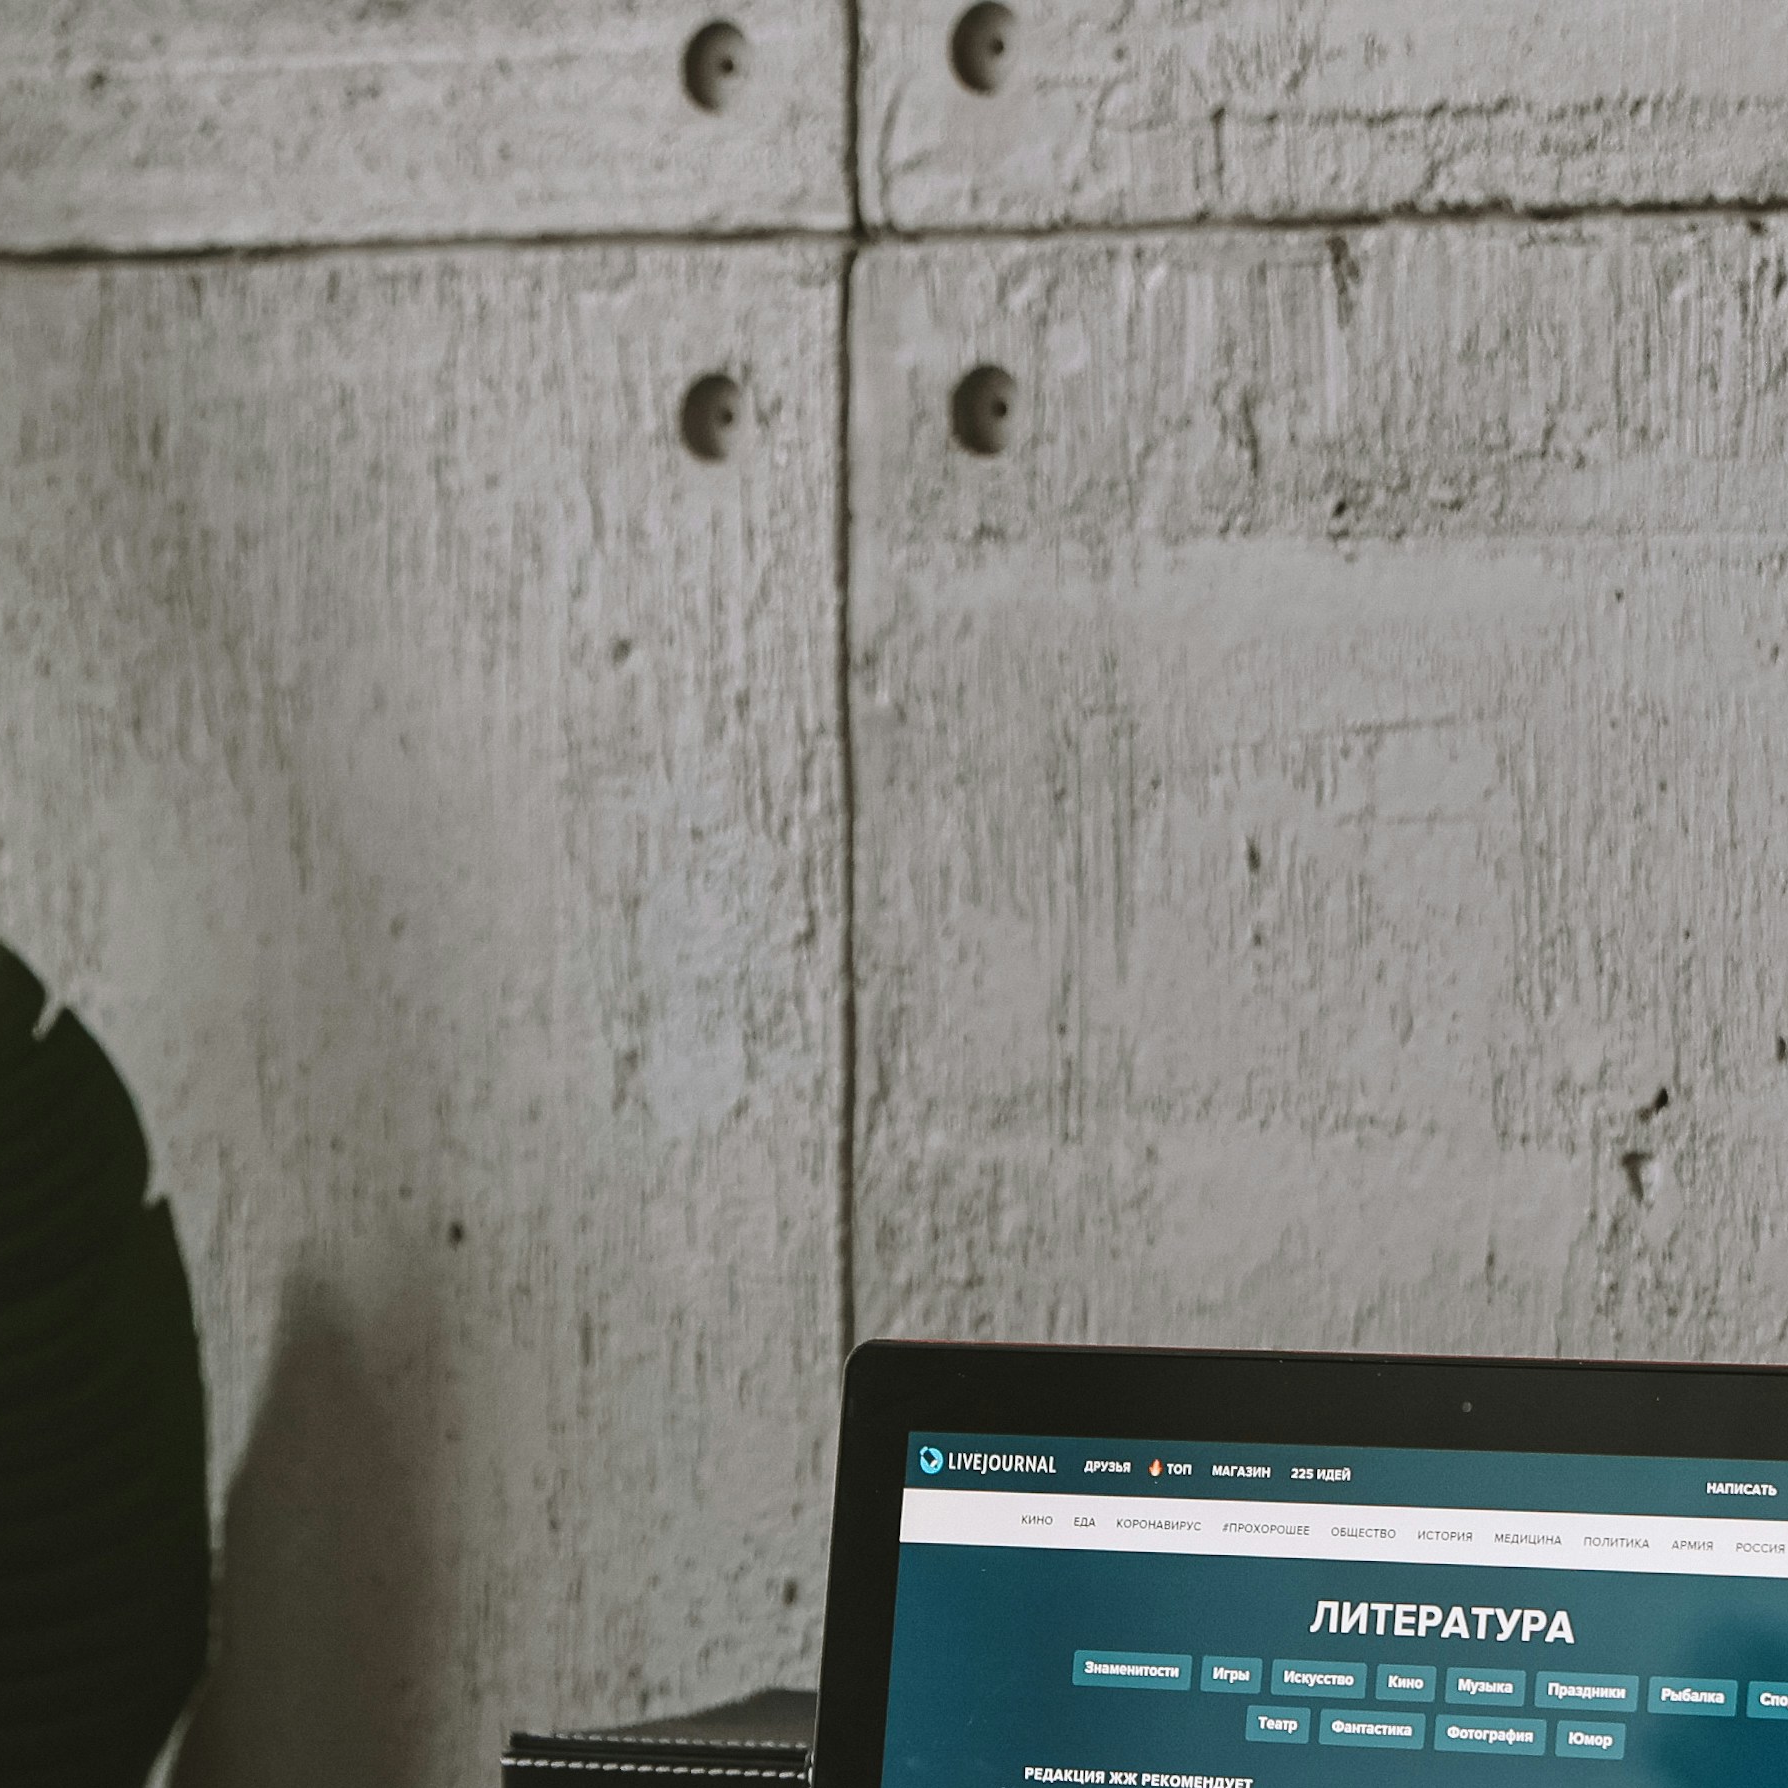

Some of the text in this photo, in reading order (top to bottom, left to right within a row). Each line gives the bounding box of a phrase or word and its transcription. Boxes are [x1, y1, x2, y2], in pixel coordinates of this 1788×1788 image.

[947, 1452, 1057, 1475] LIVEJOURNAL
[1083, 1459, 1131, 1474] ДРУЗЬЯ
[1167, 1462, 1192, 1476] ТОП
[1212, 1464, 1271, 1479] МАГАЗИН
[1290, 1466, 1352, 1482] 225 ИДЕЙ
[1706, 1481, 1778, 1498] НАПИСАТЬ
[1021, 1515, 1053, 1526] КИНО
[1073, 1516, 1096, 1529] ЕДА
[1116, 1518, 1202, 1533] КОРОНАВИРУС
[1222, 1522, 1311, 1536] #ПРОХОРОШЕЕ
[1331, 1526, 1396, 1541] ОБЩЕСТВО
[1417, 1530, 1473, 1543] ИСТОРИЯ
[1494, 1532, 1562, 1548] МЕДИЦИНА
[1583, 1536, 1650, 1549] ПОЛИТИКА
[1671, 1539, 1714, 1552] АРМИЯ
[1735, 1542, 1786, 1555] РОССИЯ
[1309, 1600, 1575, 1645] ЛИТЕРАТУРА
[1084, 1660, 1180, 1679] Знаменитости
[1212, 1666, 1251, 1683] Игры
[1283, 1670, 1355, 1687] Искусство
[1387, 1674, 1424, 1690] Кино
[1457, 1678, 1513, 1694] Музыка
[1547, 1682, 1626, 1700] Праздники
[1660, 1687, 1726, 1705] Рыбалка
[1258, 1715, 1298, 1733] Театр
[1331, 1719, 1413, 1737] Фантастика
[1446, 1724, 1534, 1745] Фотография
[1568, 1731, 1613, 1750] Юмор
[1024, 1767, 1105, 1785] РЕДАКЦИЯ
[1109, 1770, 1138, 1785] ЖЖ
